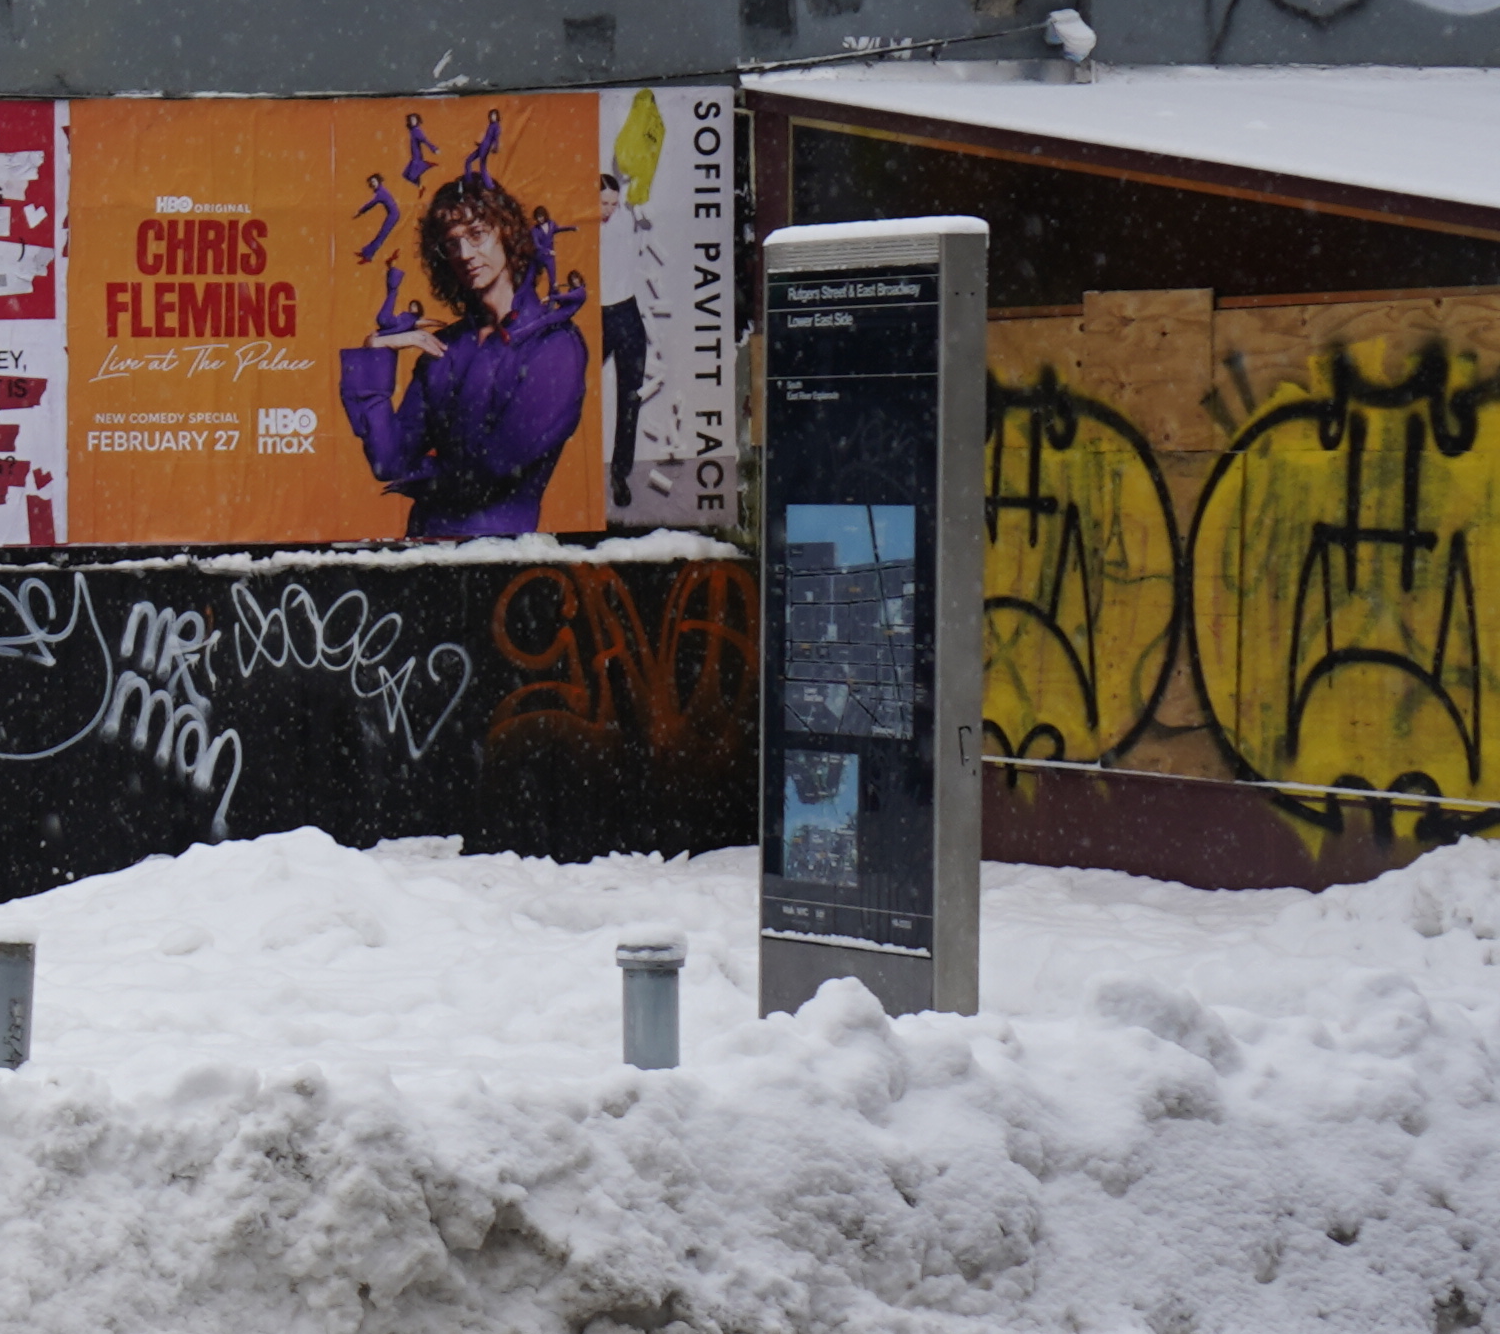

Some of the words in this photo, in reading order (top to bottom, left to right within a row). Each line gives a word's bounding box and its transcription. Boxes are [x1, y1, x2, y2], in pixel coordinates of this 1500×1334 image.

[693, 100, 721, 219] SOFIE
[155, 196, 193, 213] HBO
[194, 203, 251, 213] ORIGINAL
[136, 218, 268, 276] CHRIS
[856, 284, 876, 297] East
[877, 282, 921, 298] Broadway
[105, 280, 297, 338] FLEMING
[693, 242, 722, 387] PAVITT
[787, 315, 813, 328] Lower
[814, 314, 833, 327] East
[834, 312, 854, 326] Side
[88, 344, 145, 382] Live
[145, 348, 179, 371] at
[182, 343, 229, 378] The
[232, 340, 316, 382] Palace
[8, 378, 28, 398] IS
[95, 413, 126, 424] NEW
[129, 412, 184, 424] COMEDY
[188, 412, 240, 424] SPECIAL
[257, 407, 318, 434] HBO
[87, 430, 209, 452] FEBRUARY
[213, 430, 241, 451] 27
[257, 436, 316, 454] max
[696, 410, 725, 511] FACE
